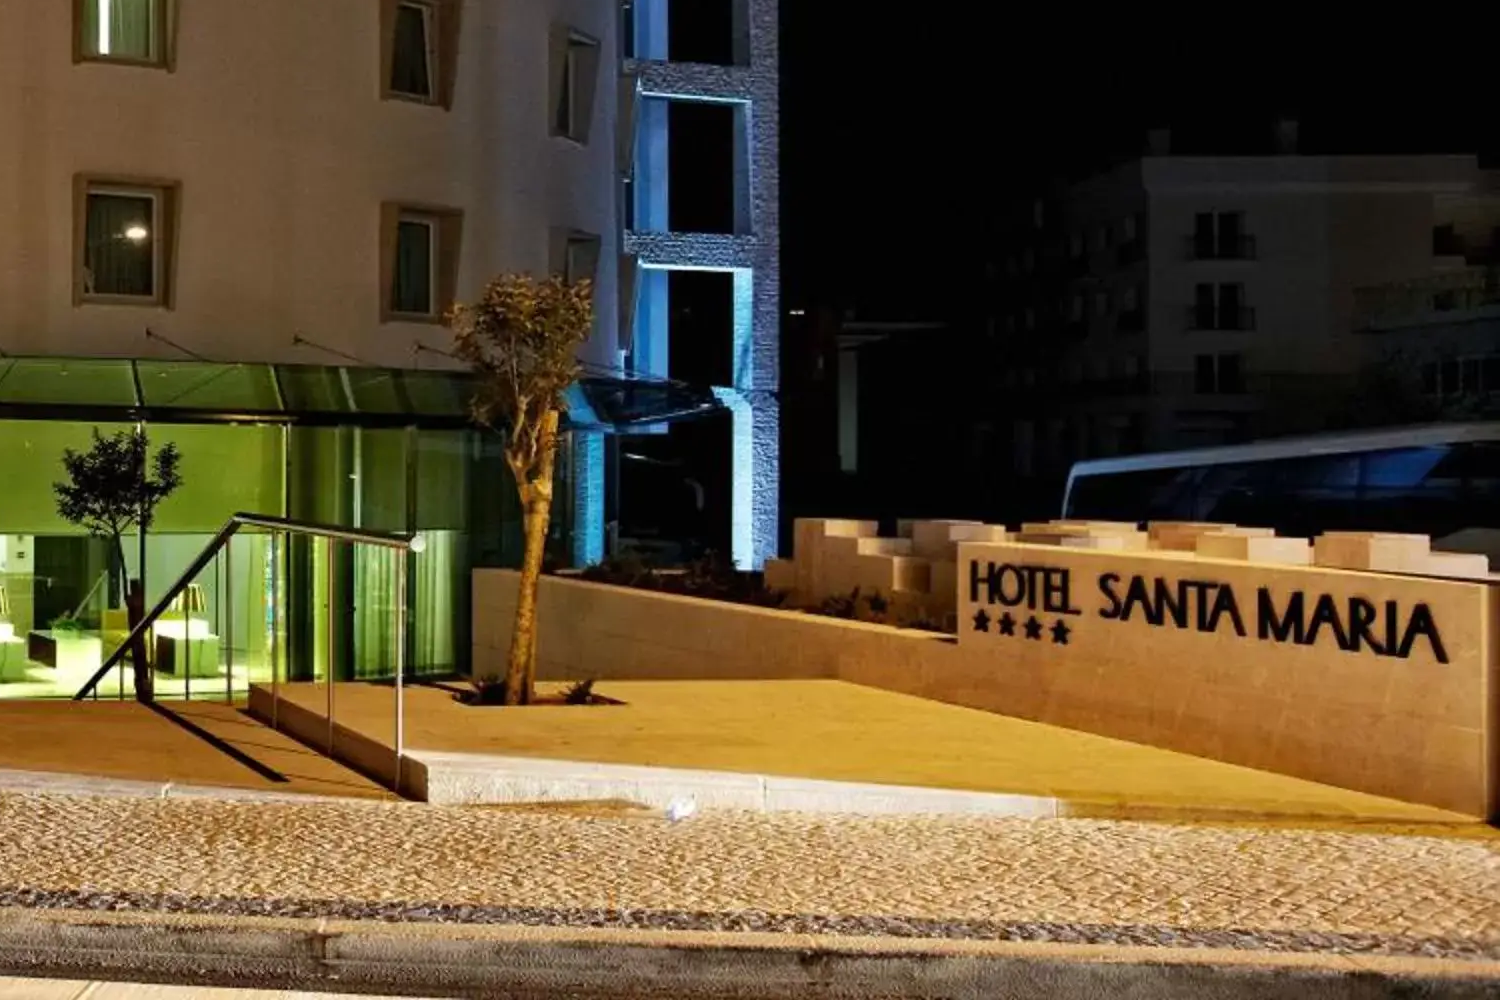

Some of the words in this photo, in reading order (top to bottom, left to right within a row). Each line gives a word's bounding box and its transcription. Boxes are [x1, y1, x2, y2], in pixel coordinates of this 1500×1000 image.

[969, 559, 1082, 616] HOTEL
[1098, 572, 1247, 637] SANTA
[1257, 586, 1450, 665] MARIA
